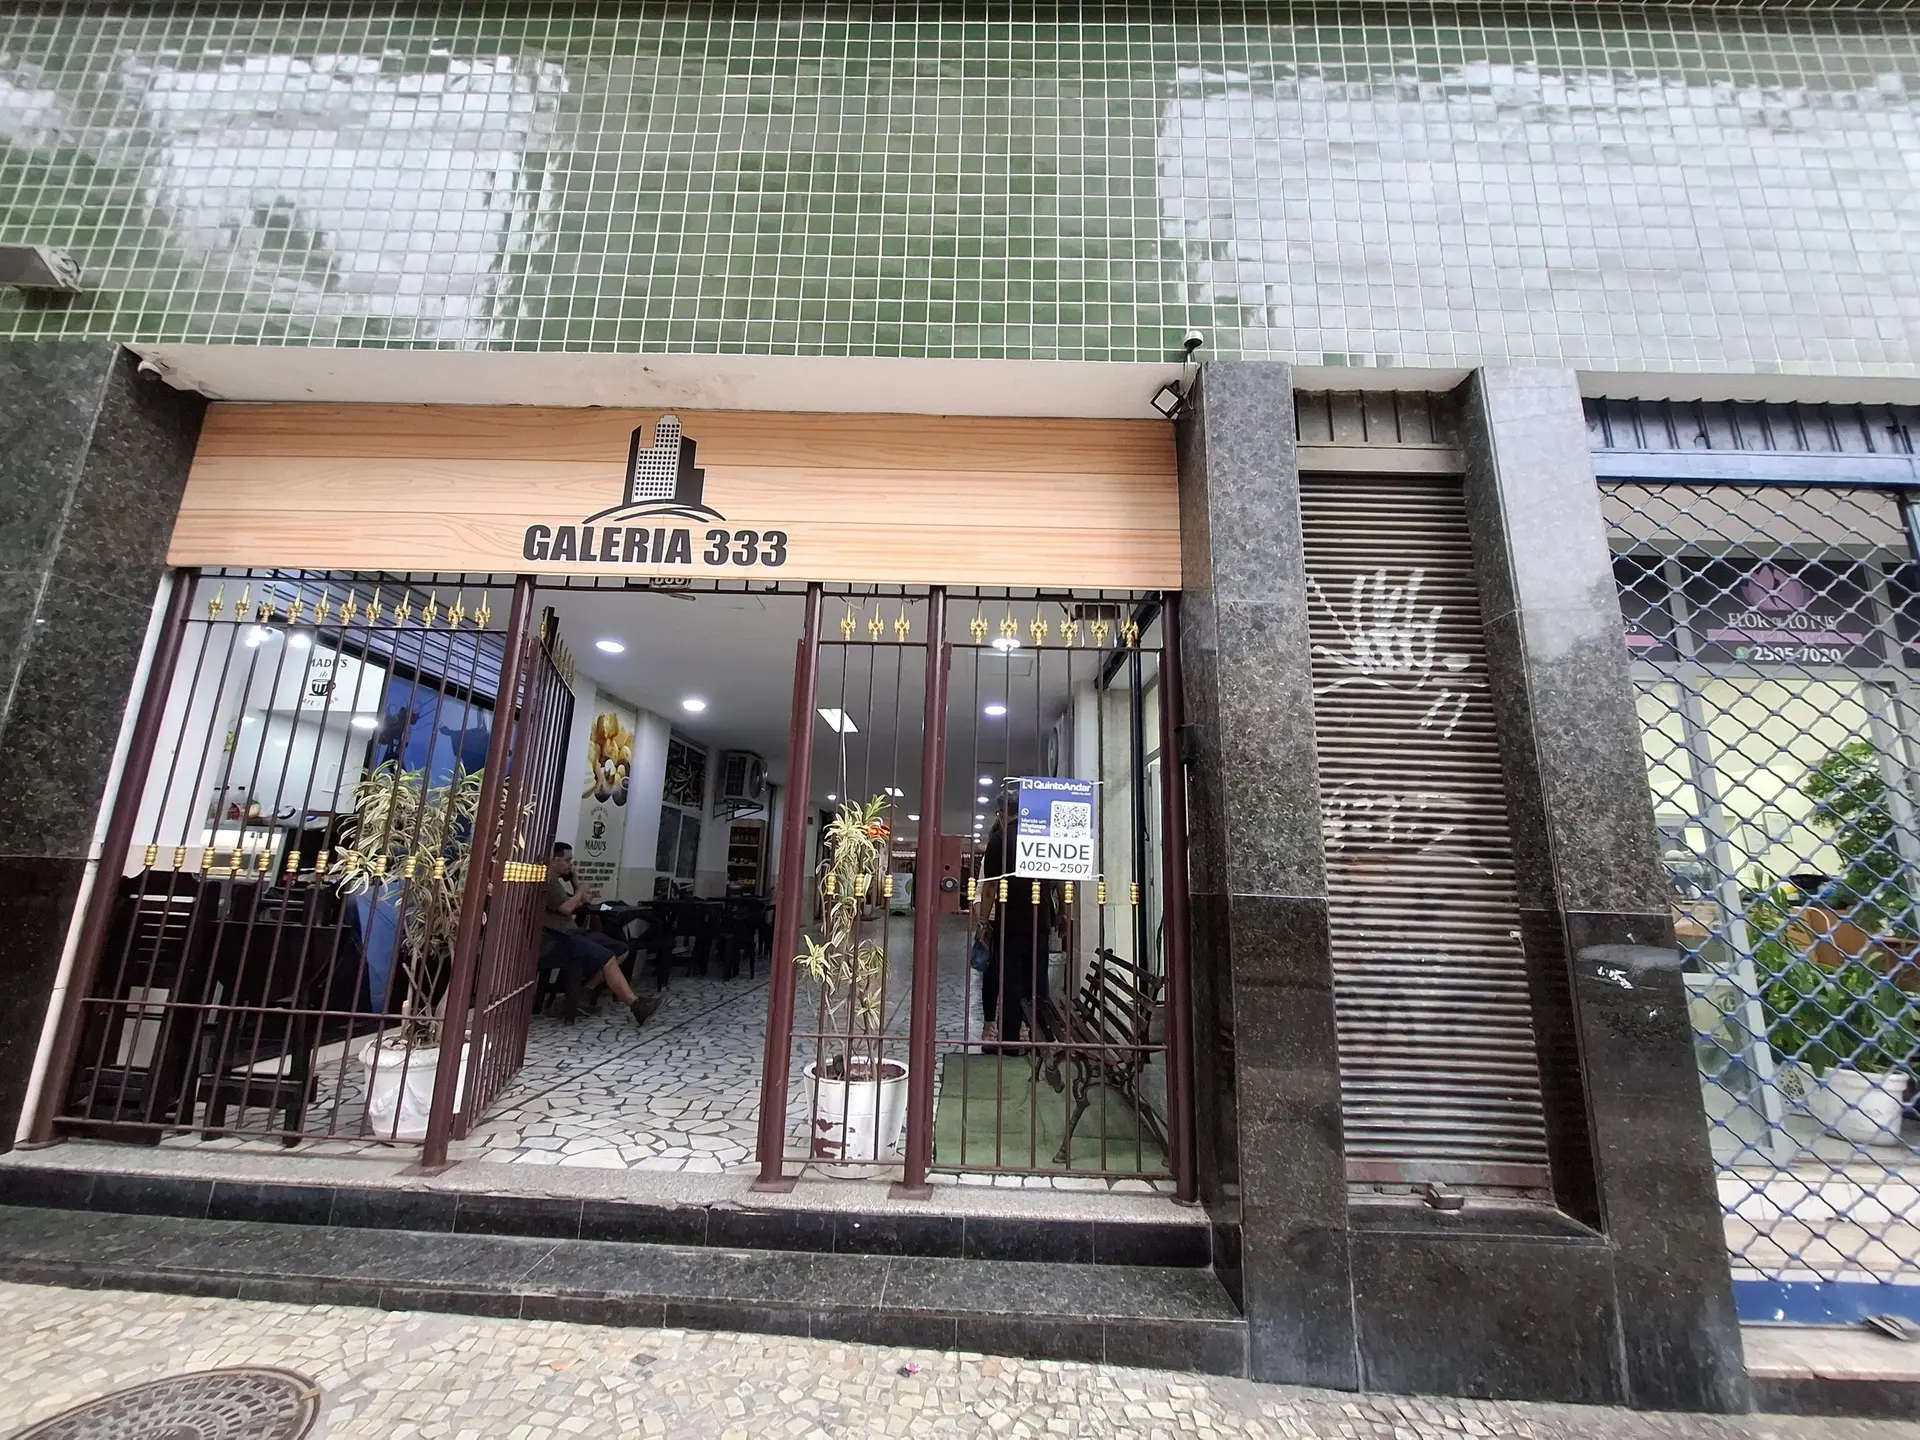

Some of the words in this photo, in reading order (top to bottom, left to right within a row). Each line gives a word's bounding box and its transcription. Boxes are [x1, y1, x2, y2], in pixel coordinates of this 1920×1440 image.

[522, 524, 692, 565] GALERIA
[703, 529, 788, 567] 333
[1754, 646, 1841, 662] 2505-7020
[1034, 781, 1091, 791] QuintoAndar
[1021, 841, 1090, 860] VENDE
[1019, 860, 1090, 874] 4020-2507
